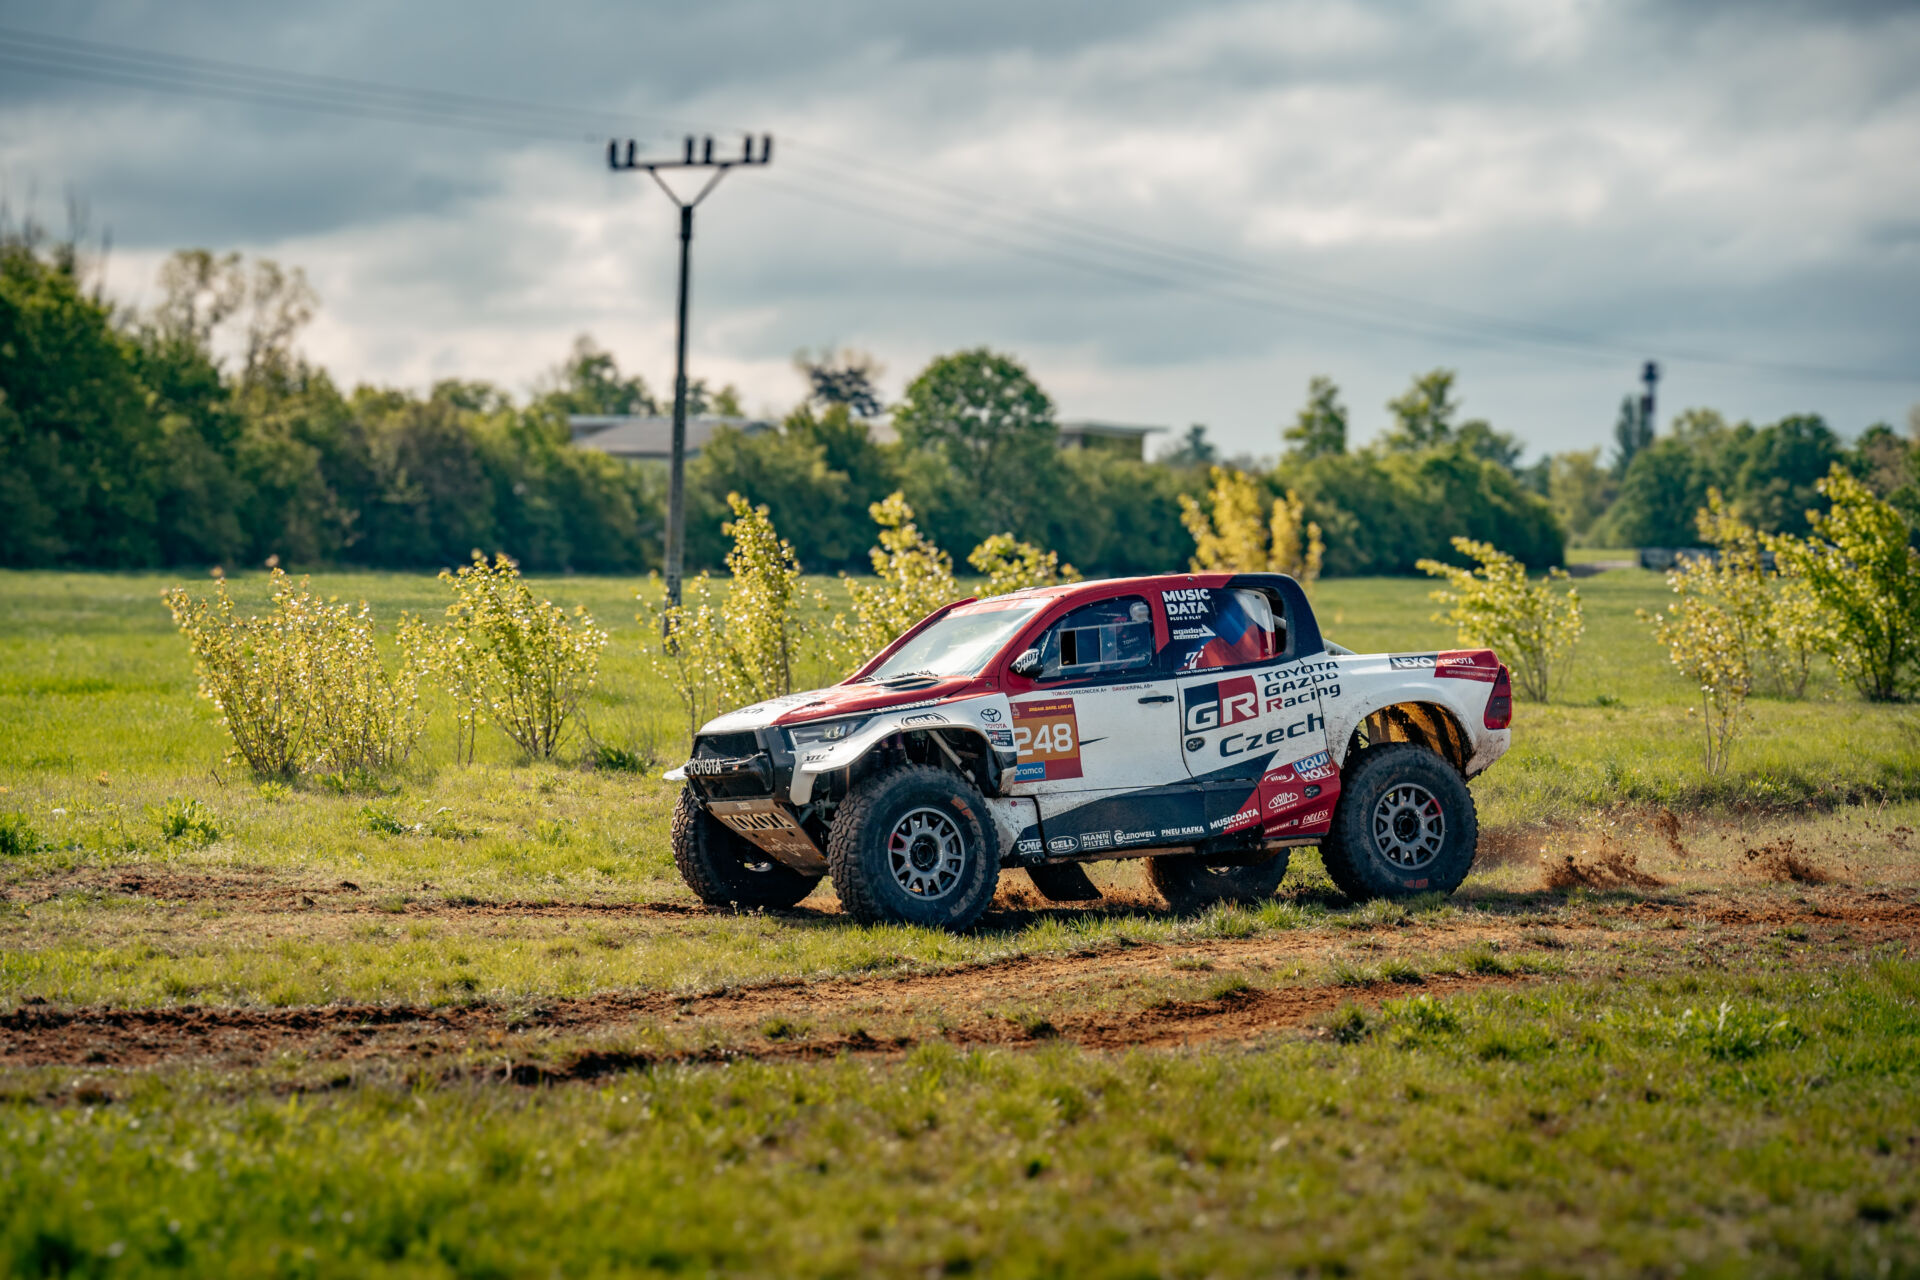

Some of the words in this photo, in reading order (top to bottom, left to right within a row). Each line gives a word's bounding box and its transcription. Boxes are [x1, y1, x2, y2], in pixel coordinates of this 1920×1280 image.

[1162, 589, 1211, 602] MUSIC
[1166, 602, 1209, 615] DATA
[1016, 652, 1038, 672] SHOT
[1391, 657, 1436, 669] NEXO
[1440, 656, 1475, 665] TOYOTA
[1258, 661, 1339, 682] TOYOTA
[1264, 672, 1339, 697] GAZOO
[1266, 684, 1341, 713] Racing
[1187, 691, 1257, 732] GR
[1014, 723, 1073, 756] 248
[1220, 713, 1325, 758] Czech
[689, 758, 722, 775] TOYOTA
[1015, 767, 1043, 776] aramco
[1295, 753, 1327, 773] LIQUI
[1301, 764, 1331, 781] MOLY
[721, 812, 796, 831] TOYOTA
[1210, 808, 1259, 829] MUSICDATA
[1303, 809, 1329, 825] ENDLESS
[1082, 833, 1109, 841] MANN
[1161, 828, 1180, 836] PNEU
[1182, 825, 1204, 835] KAFKA
[1018, 841, 1042, 852] OMP
[1051, 839, 1075, 849] BELL
[1084, 839, 1110, 848] FILTER
